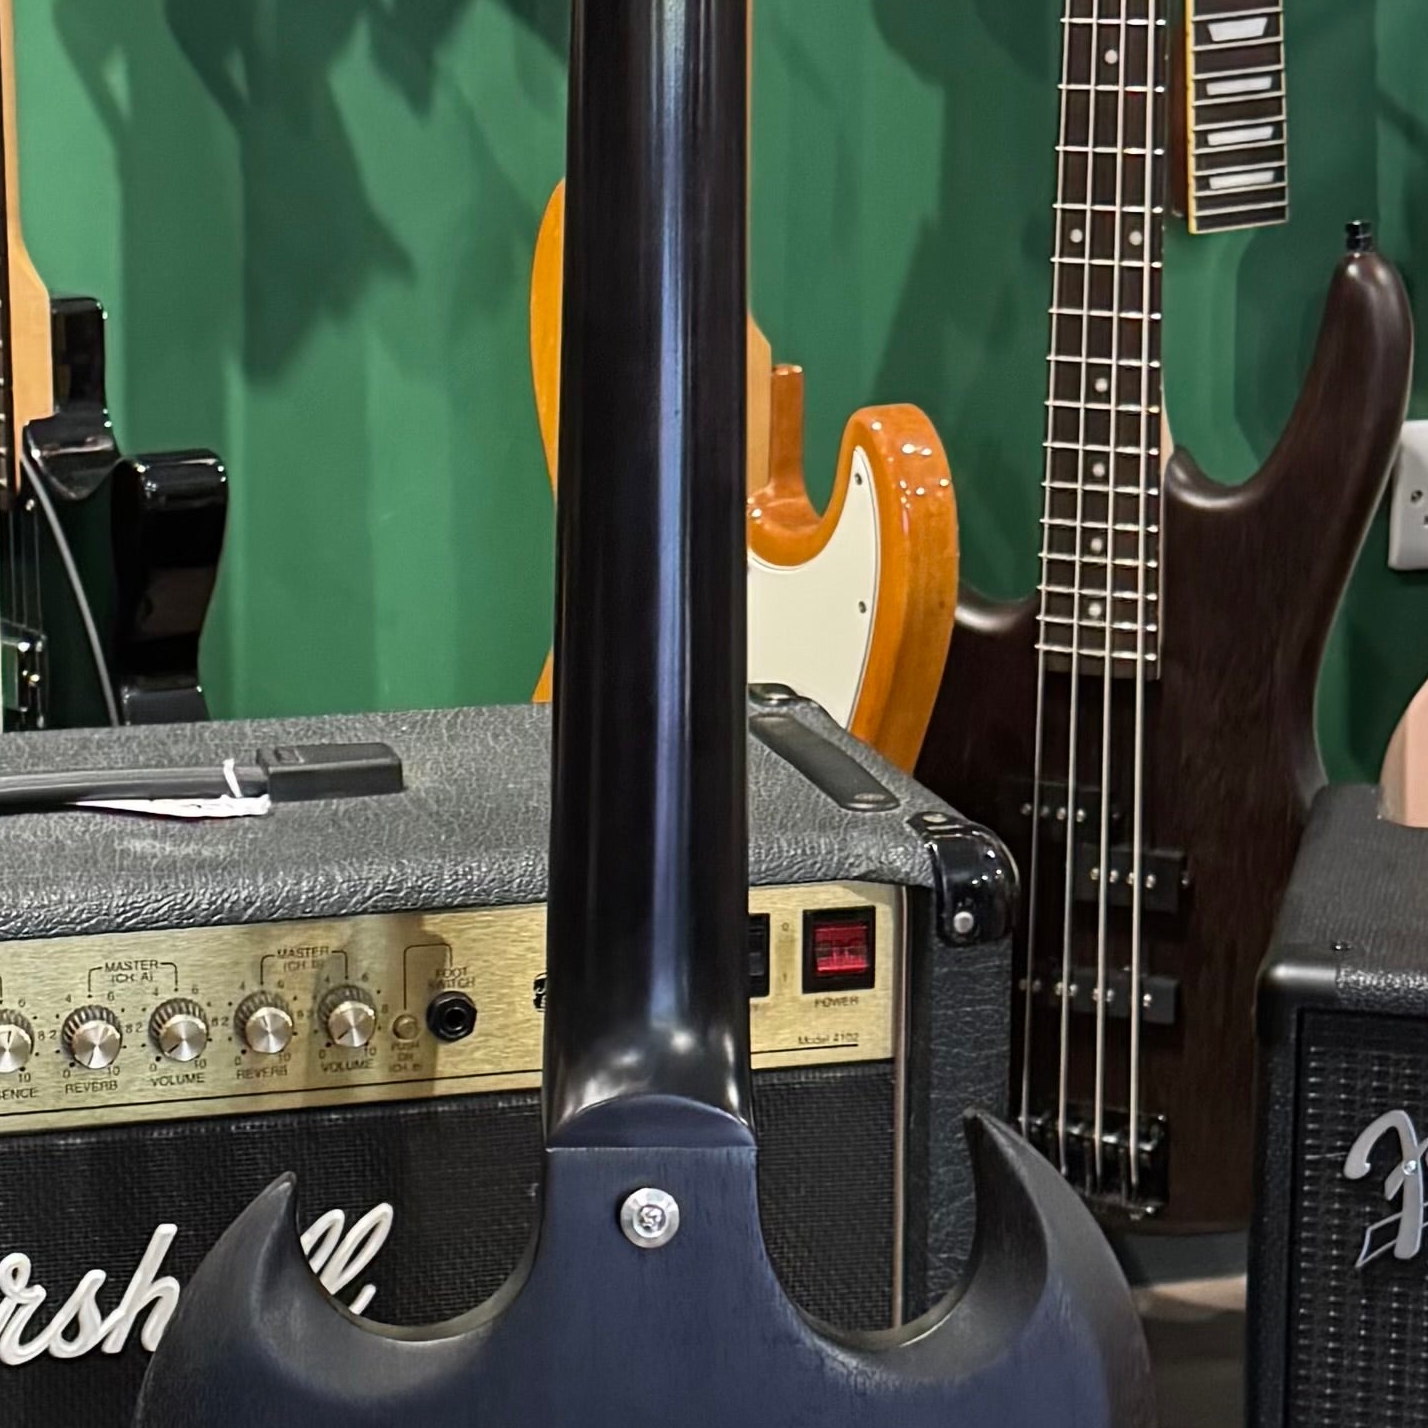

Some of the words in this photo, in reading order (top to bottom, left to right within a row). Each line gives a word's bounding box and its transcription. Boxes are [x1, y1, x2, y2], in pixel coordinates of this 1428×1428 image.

[277, 946, 330, 960] MASTER
[105, 959, 159, 974] MASTER
[814, 995, 860, 1009] POWER
[236, 1064, 288, 1080] REVERB
[321, 1058, 375, 1072] VOLUME
[150, 1073, 205, 1087] VOLUME
[65, 1080, 118, 1095] REVERB
